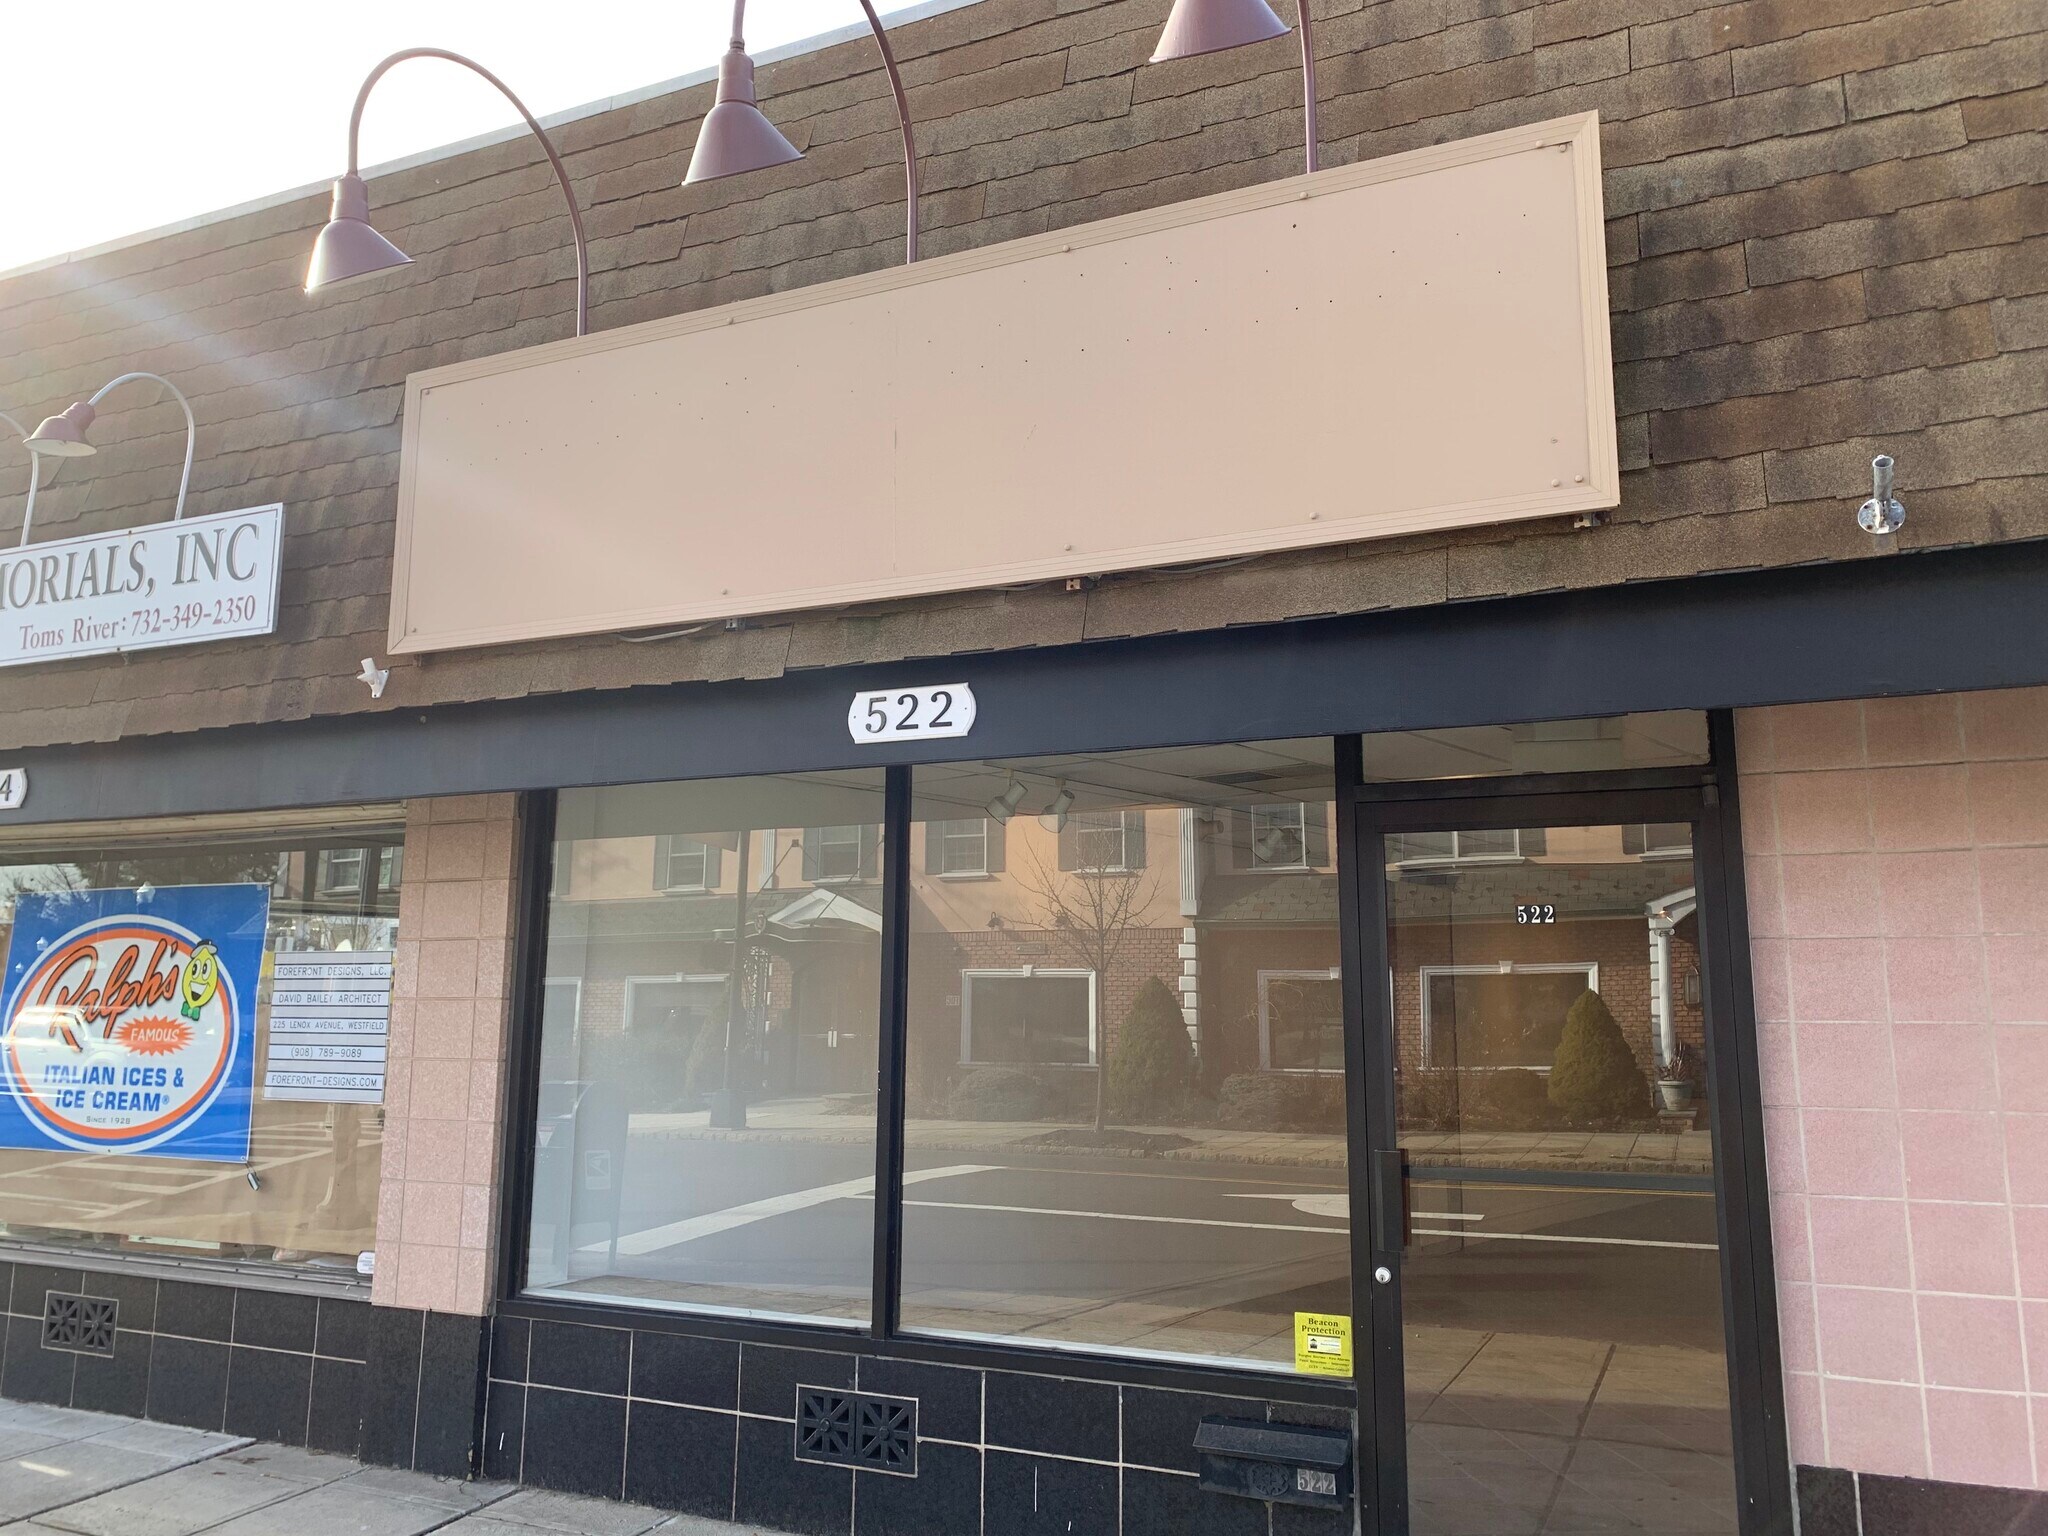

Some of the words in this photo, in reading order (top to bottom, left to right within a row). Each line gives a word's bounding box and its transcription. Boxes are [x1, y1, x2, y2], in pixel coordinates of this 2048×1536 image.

[172, 523, 259, 586] INC
[19, 625, 63, 650] Toms
[131, 595, 256, 637] 732-349-2350
[865, 690, 953, 734] 522
[1517, 904, 1555, 924] 522
[277, 966, 323, 977] FOREFRONT
[327, 966, 365, 977] DESIGNS,
[369, 966, 387, 977] LLC.
[36, 937, 180, 1054] Ralph's
[278, 993, 302, 1004] DAVID
[306, 993, 333, 1004] BAILEY
[338, 993, 382, 1004] ARCHITECT
[272, 1020, 286, 1030] 225
[289, 1020, 311, 1030] LENOX
[314, 1020, 344, 1031] AVENUE,
[348, 1021, 385, 1031] WESTFIELD
[130, 1027, 180, 1043] FAMOUS
[290, 1047, 314, 1059] (908)
[318, 1047, 362, 1059] 789-9089
[43, 1064, 116, 1086] ITALIAN
[122, 1066, 168, 1088] ICES
[173, 1067, 185, 1088] &
[271, 1074, 378, 1088] FOREFRONT-DESIGNS.COM
[55, 1088, 86, 1109] ICE
[110, 1116, 131, 1125] 1928
[1301, 1325, 1346, 1336] Protection
[1308, 1318, 1339, 1327] Beacon
[1299, 1469, 1335, 1494] 522
